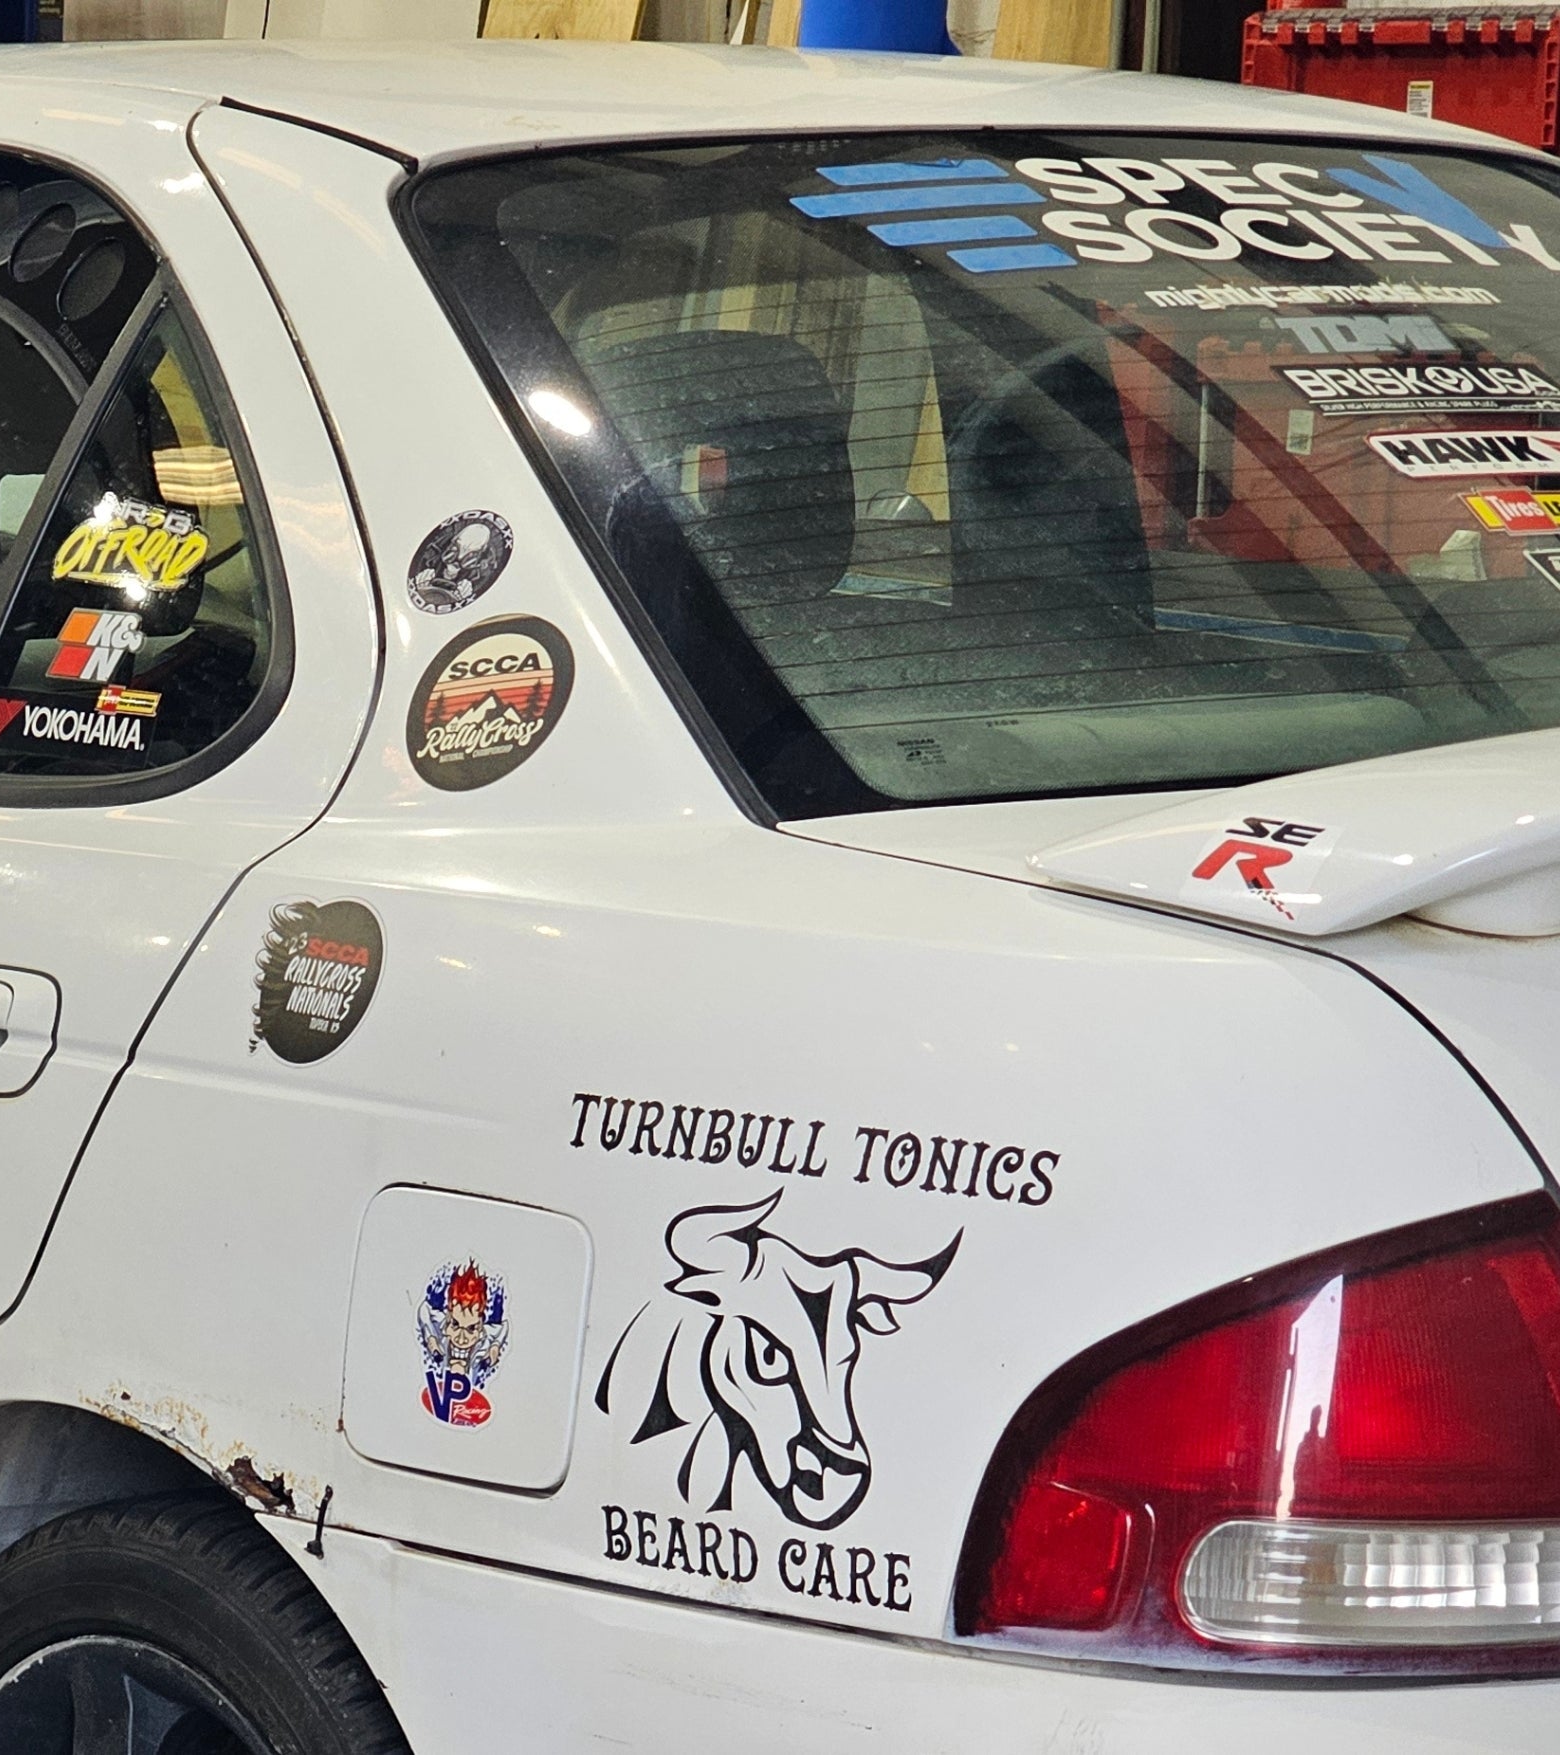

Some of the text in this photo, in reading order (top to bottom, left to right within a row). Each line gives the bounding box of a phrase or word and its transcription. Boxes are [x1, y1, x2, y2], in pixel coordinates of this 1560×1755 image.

[1014, 157, 1365, 205] SPEC
[1041, 206, 1560, 272] SOCIETY
[1283, 366, 1560, 398] BRISK USA
[1378, 435, 1554, 466] HAWK
[1484, 495, 1544, 522] Tires
[448, 652, 541, 681] SCCA
[416, 717, 544, 760] RallyCross
[1225, 816, 1326, 847] SE
[1191, 838, 1295, 905] R
[306, 936, 370, 967] SCCA
[284, 955, 367, 994] RALLYCROSS
[286, 985, 355, 1022] NATIONALS
[569, 1092, 1062, 1207] TURNBULL TONICS
[425, 1369, 472, 1423] VP
[601, 1504, 913, 1613] BEARD CARE
